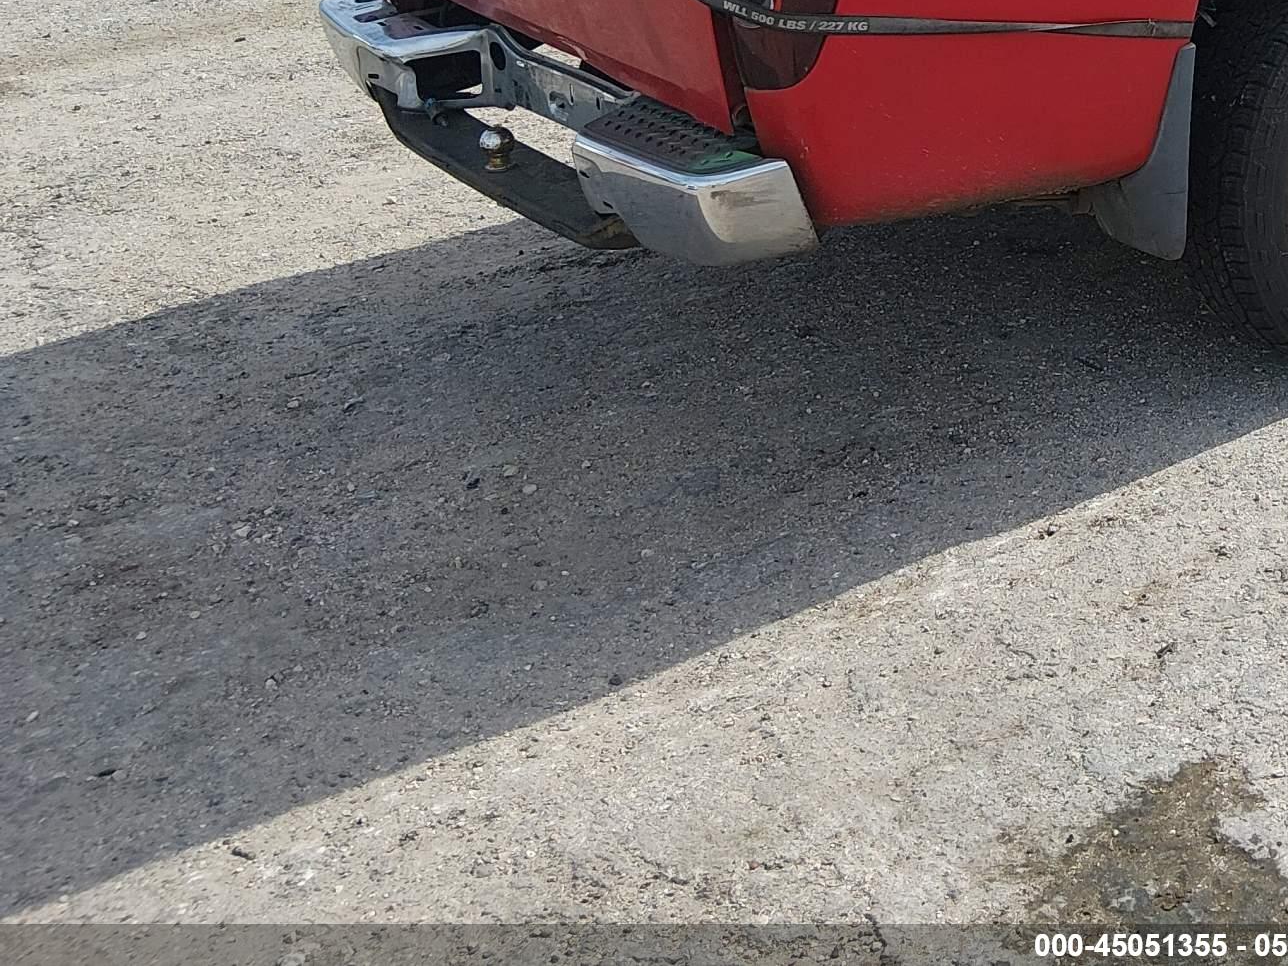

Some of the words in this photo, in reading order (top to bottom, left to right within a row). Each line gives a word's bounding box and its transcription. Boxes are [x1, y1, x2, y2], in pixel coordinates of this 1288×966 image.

[723, 0, 748, 18] WLL
[750, 11, 775, 26] 500
[778, 18, 806, 31] LBS
[809, 20, 816, 31] /
[818, 21, 844, 31] 227
[847, 21, 869, 31] KG
